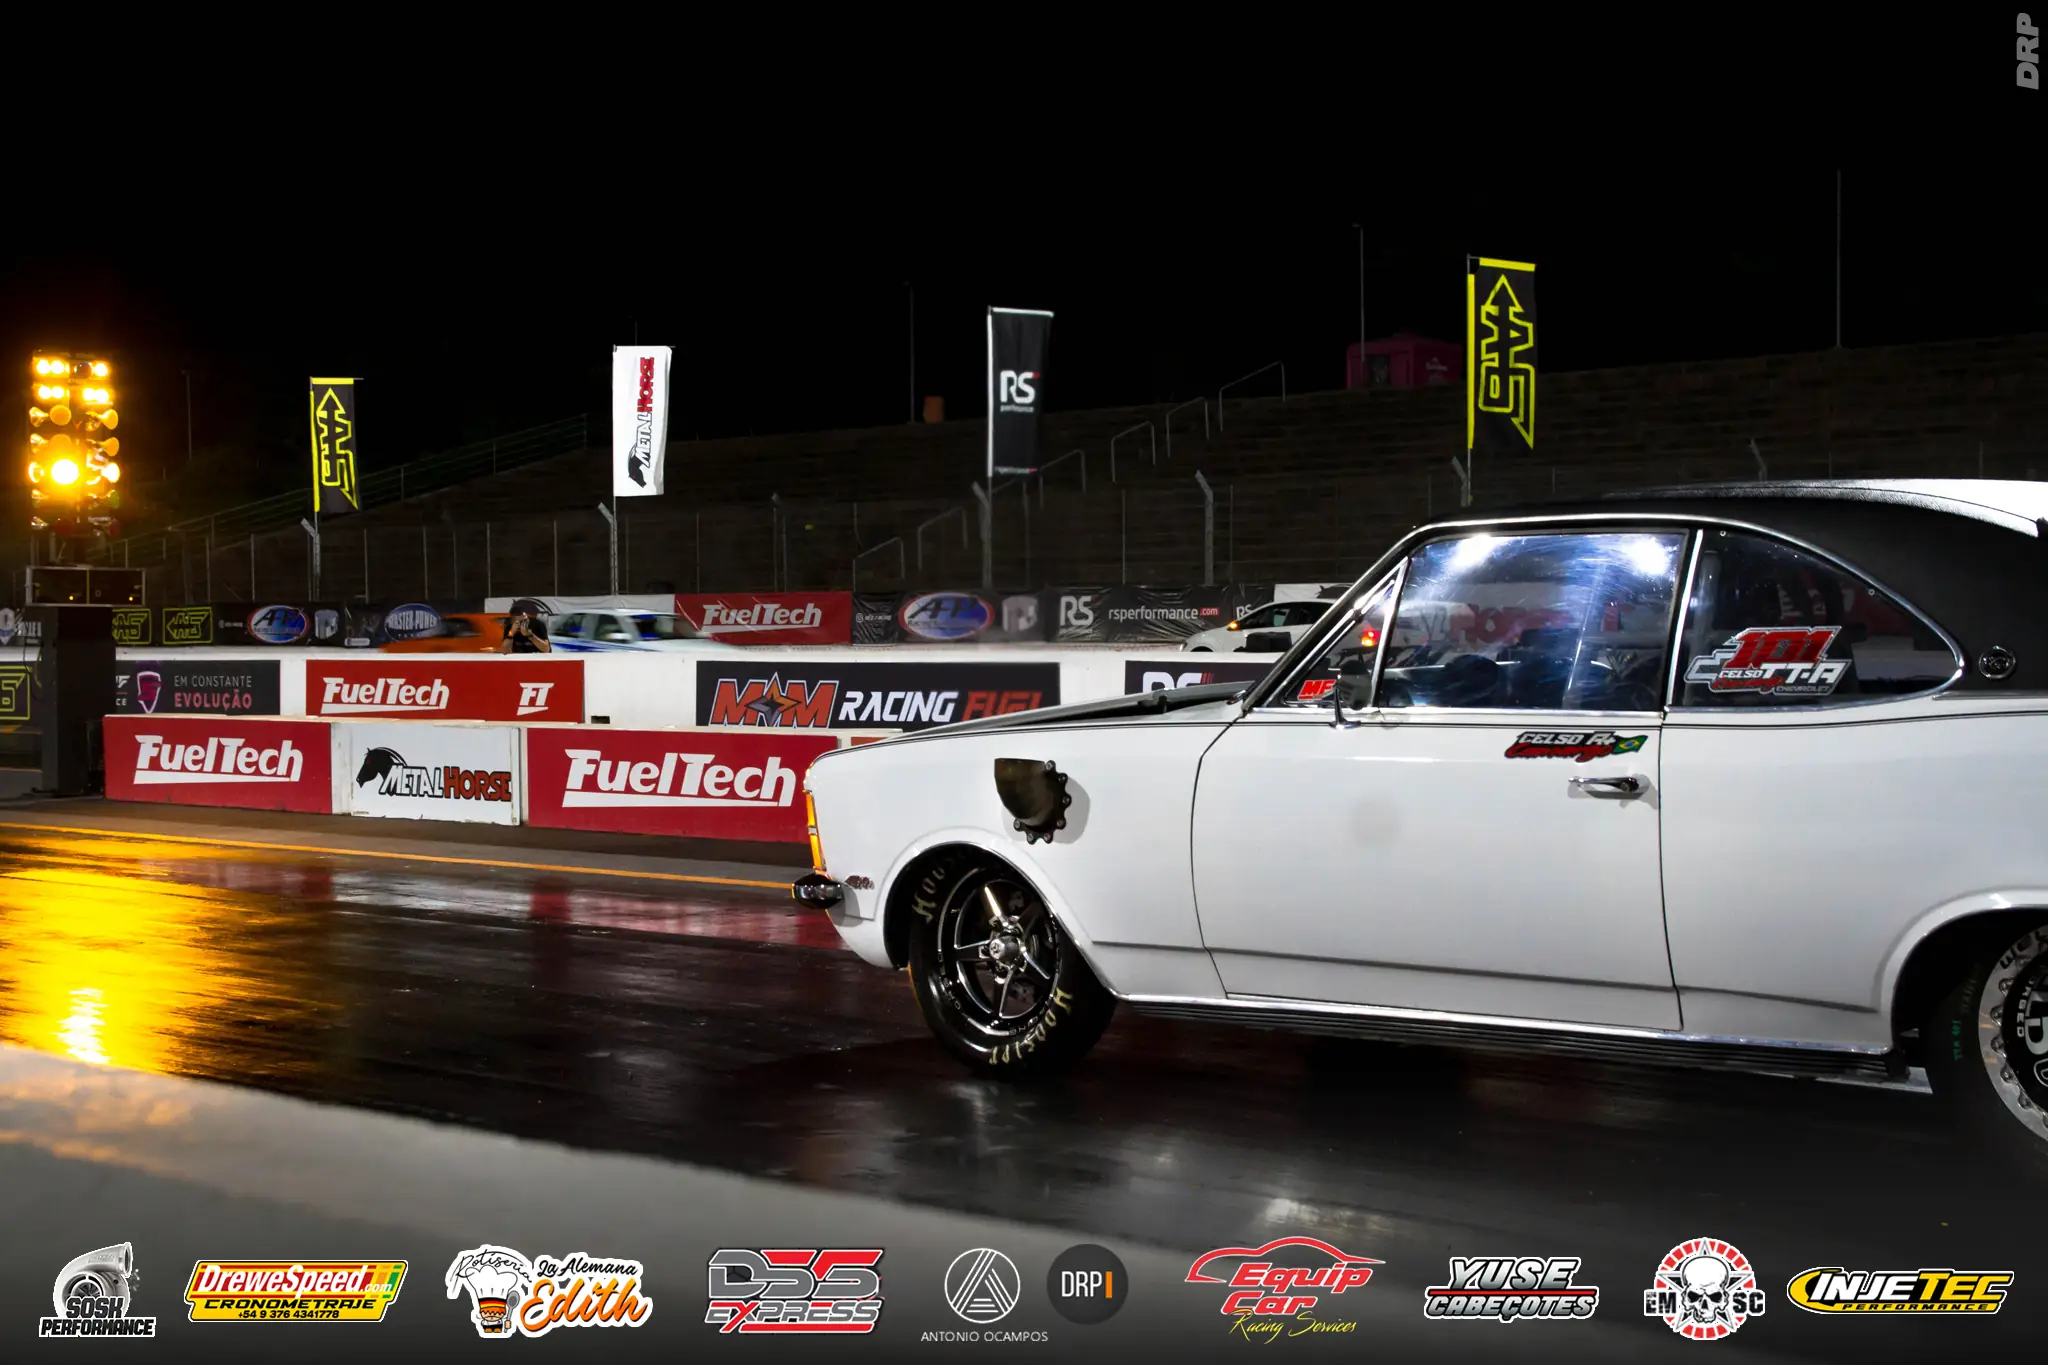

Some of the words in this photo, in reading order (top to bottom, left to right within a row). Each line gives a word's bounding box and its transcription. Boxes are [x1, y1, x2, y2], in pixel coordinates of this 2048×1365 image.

[1000, 370, 1037, 404] RS
[702, 603, 822, 629] FuelTech
[1061, 596, 1096, 626] RS
[174, 676, 187, 687] EM
[191, 676, 252, 687] CONSTANTE
[322, 677, 450, 711] FuelTech
[174, 689, 252, 710] EVOLUÇÃO
[839, 691, 958, 722] RACING
[134, 734, 304, 783] FuelTech
[564, 749, 796, 807] FuelTech
